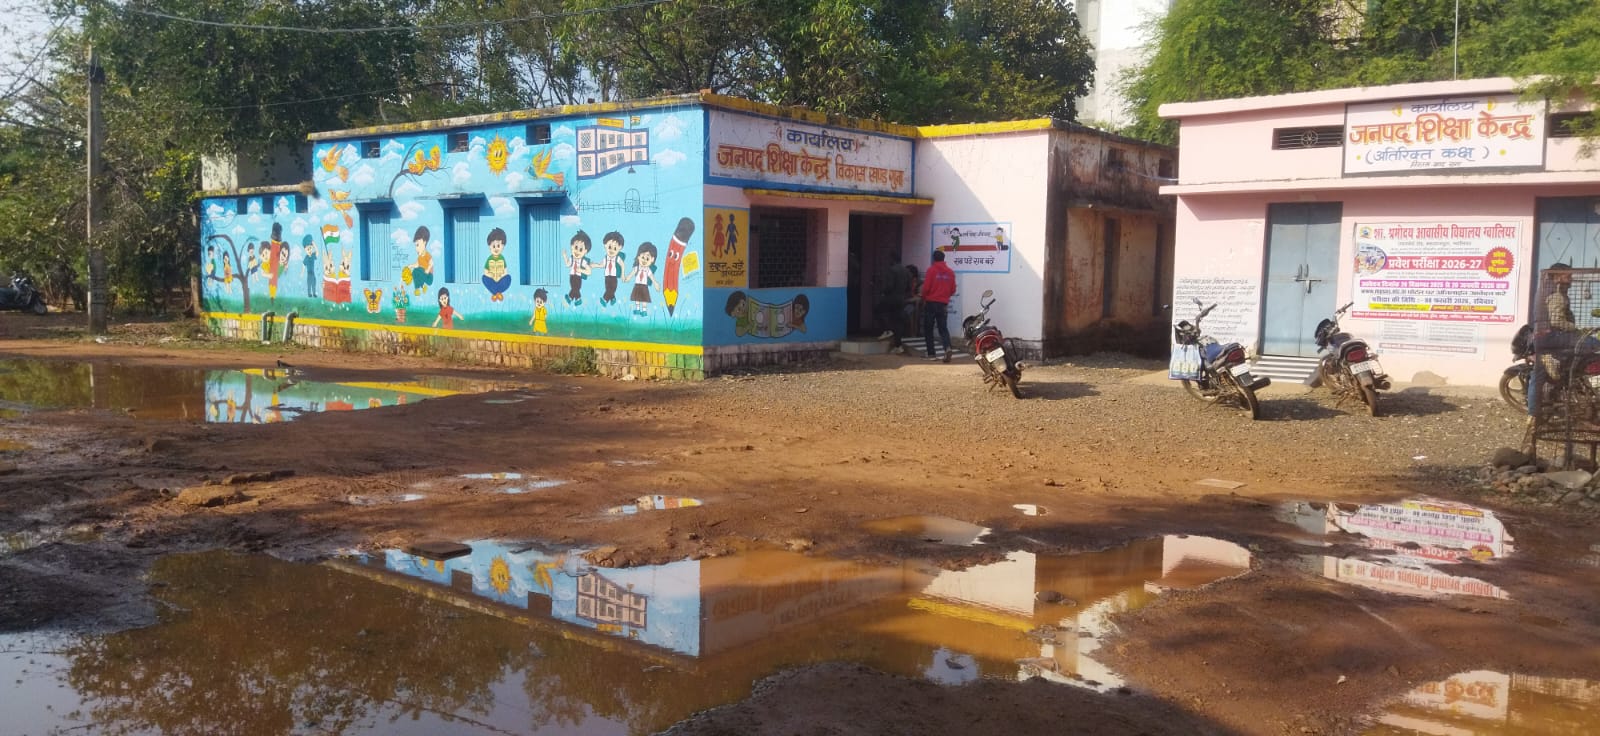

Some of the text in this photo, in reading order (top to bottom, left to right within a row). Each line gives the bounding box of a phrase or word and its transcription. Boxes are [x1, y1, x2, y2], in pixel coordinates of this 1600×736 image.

[1410, 98, 1480, 114] कार्यालय
[1349, 110, 1535, 145] जनपद शिक्षा केन्द्र
[786, 129, 853, 152] कार्यालय
[717, 142, 905, 190] जनपद शिक्षा केन्द्र विकास खण्ड गुना
[1388, 225, 1414, 240] श्रमोदय
[1416, 224, 1449, 240] आवासीय
[1451, 223, 1481, 240] विद्यालय
[1483, 223, 1516, 239] ग्वालियर
[1388, 256, 1482, 269] प्रवेश परीक्षा 2026-27
